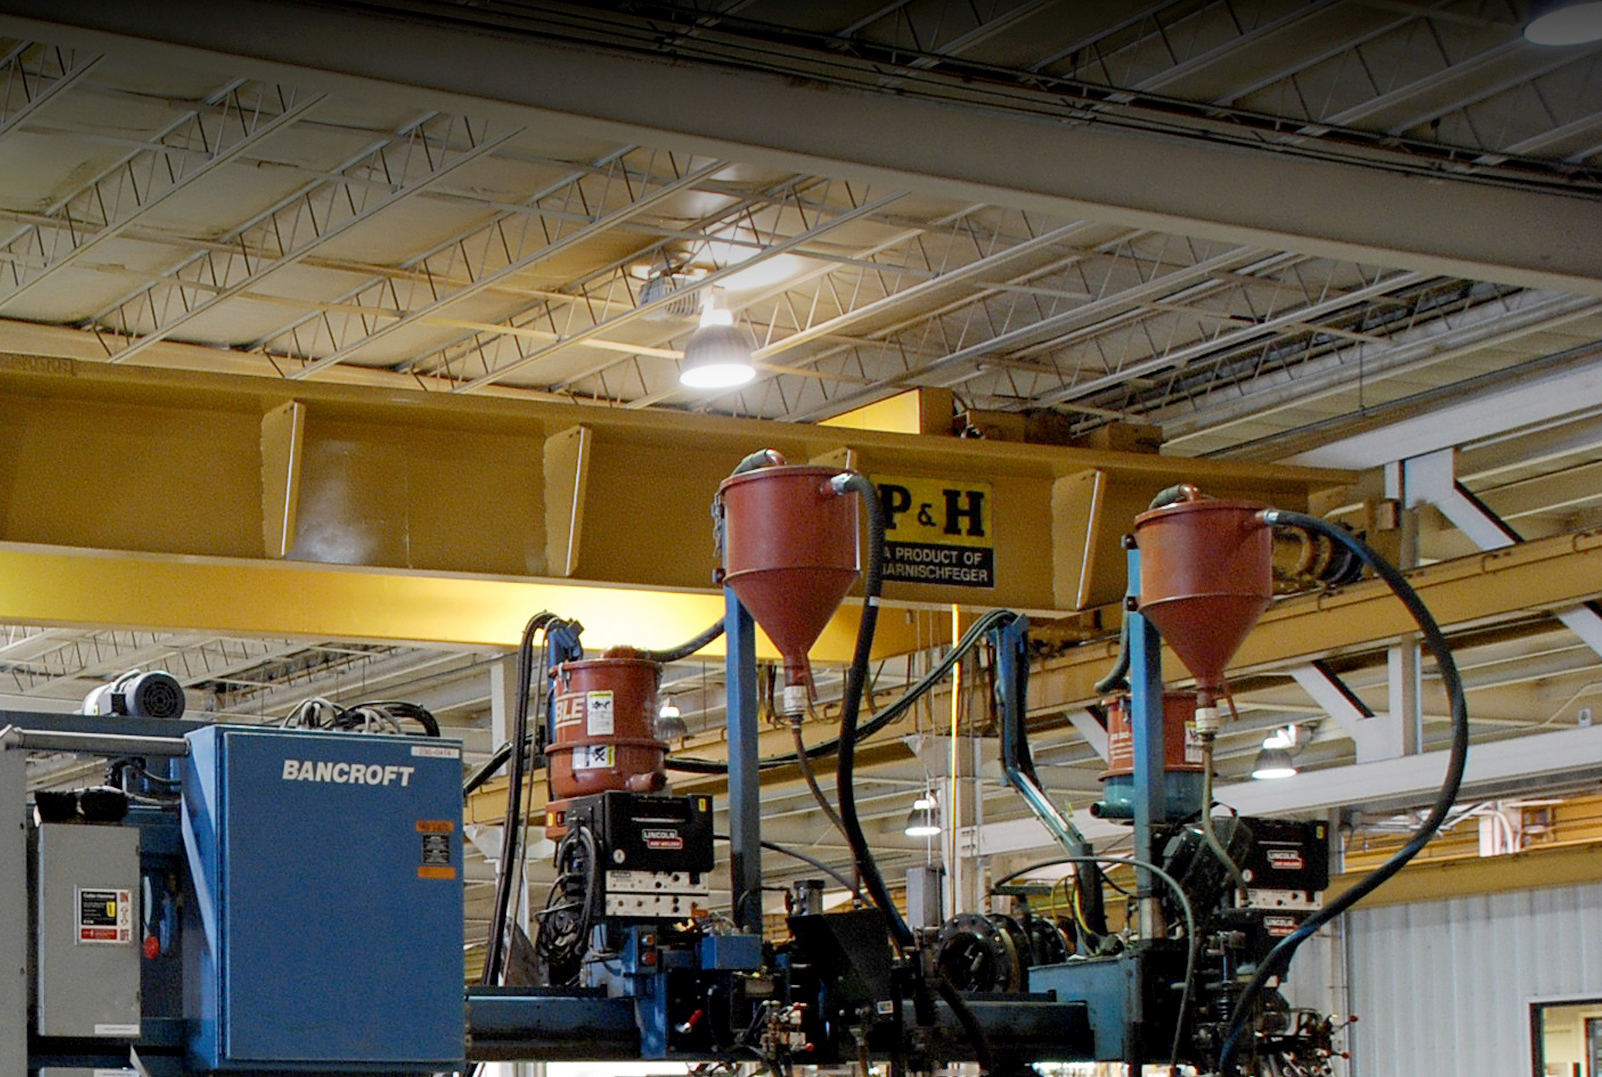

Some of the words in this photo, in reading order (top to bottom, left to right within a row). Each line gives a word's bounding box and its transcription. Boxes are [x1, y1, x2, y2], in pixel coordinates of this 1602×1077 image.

[895, 547, 959, 564] PRODUCT
[962, 551, 983, 566] OF
[282, 759, 415, 787] BANCROFT
[643, 831, 676, 840] LINCOLN
